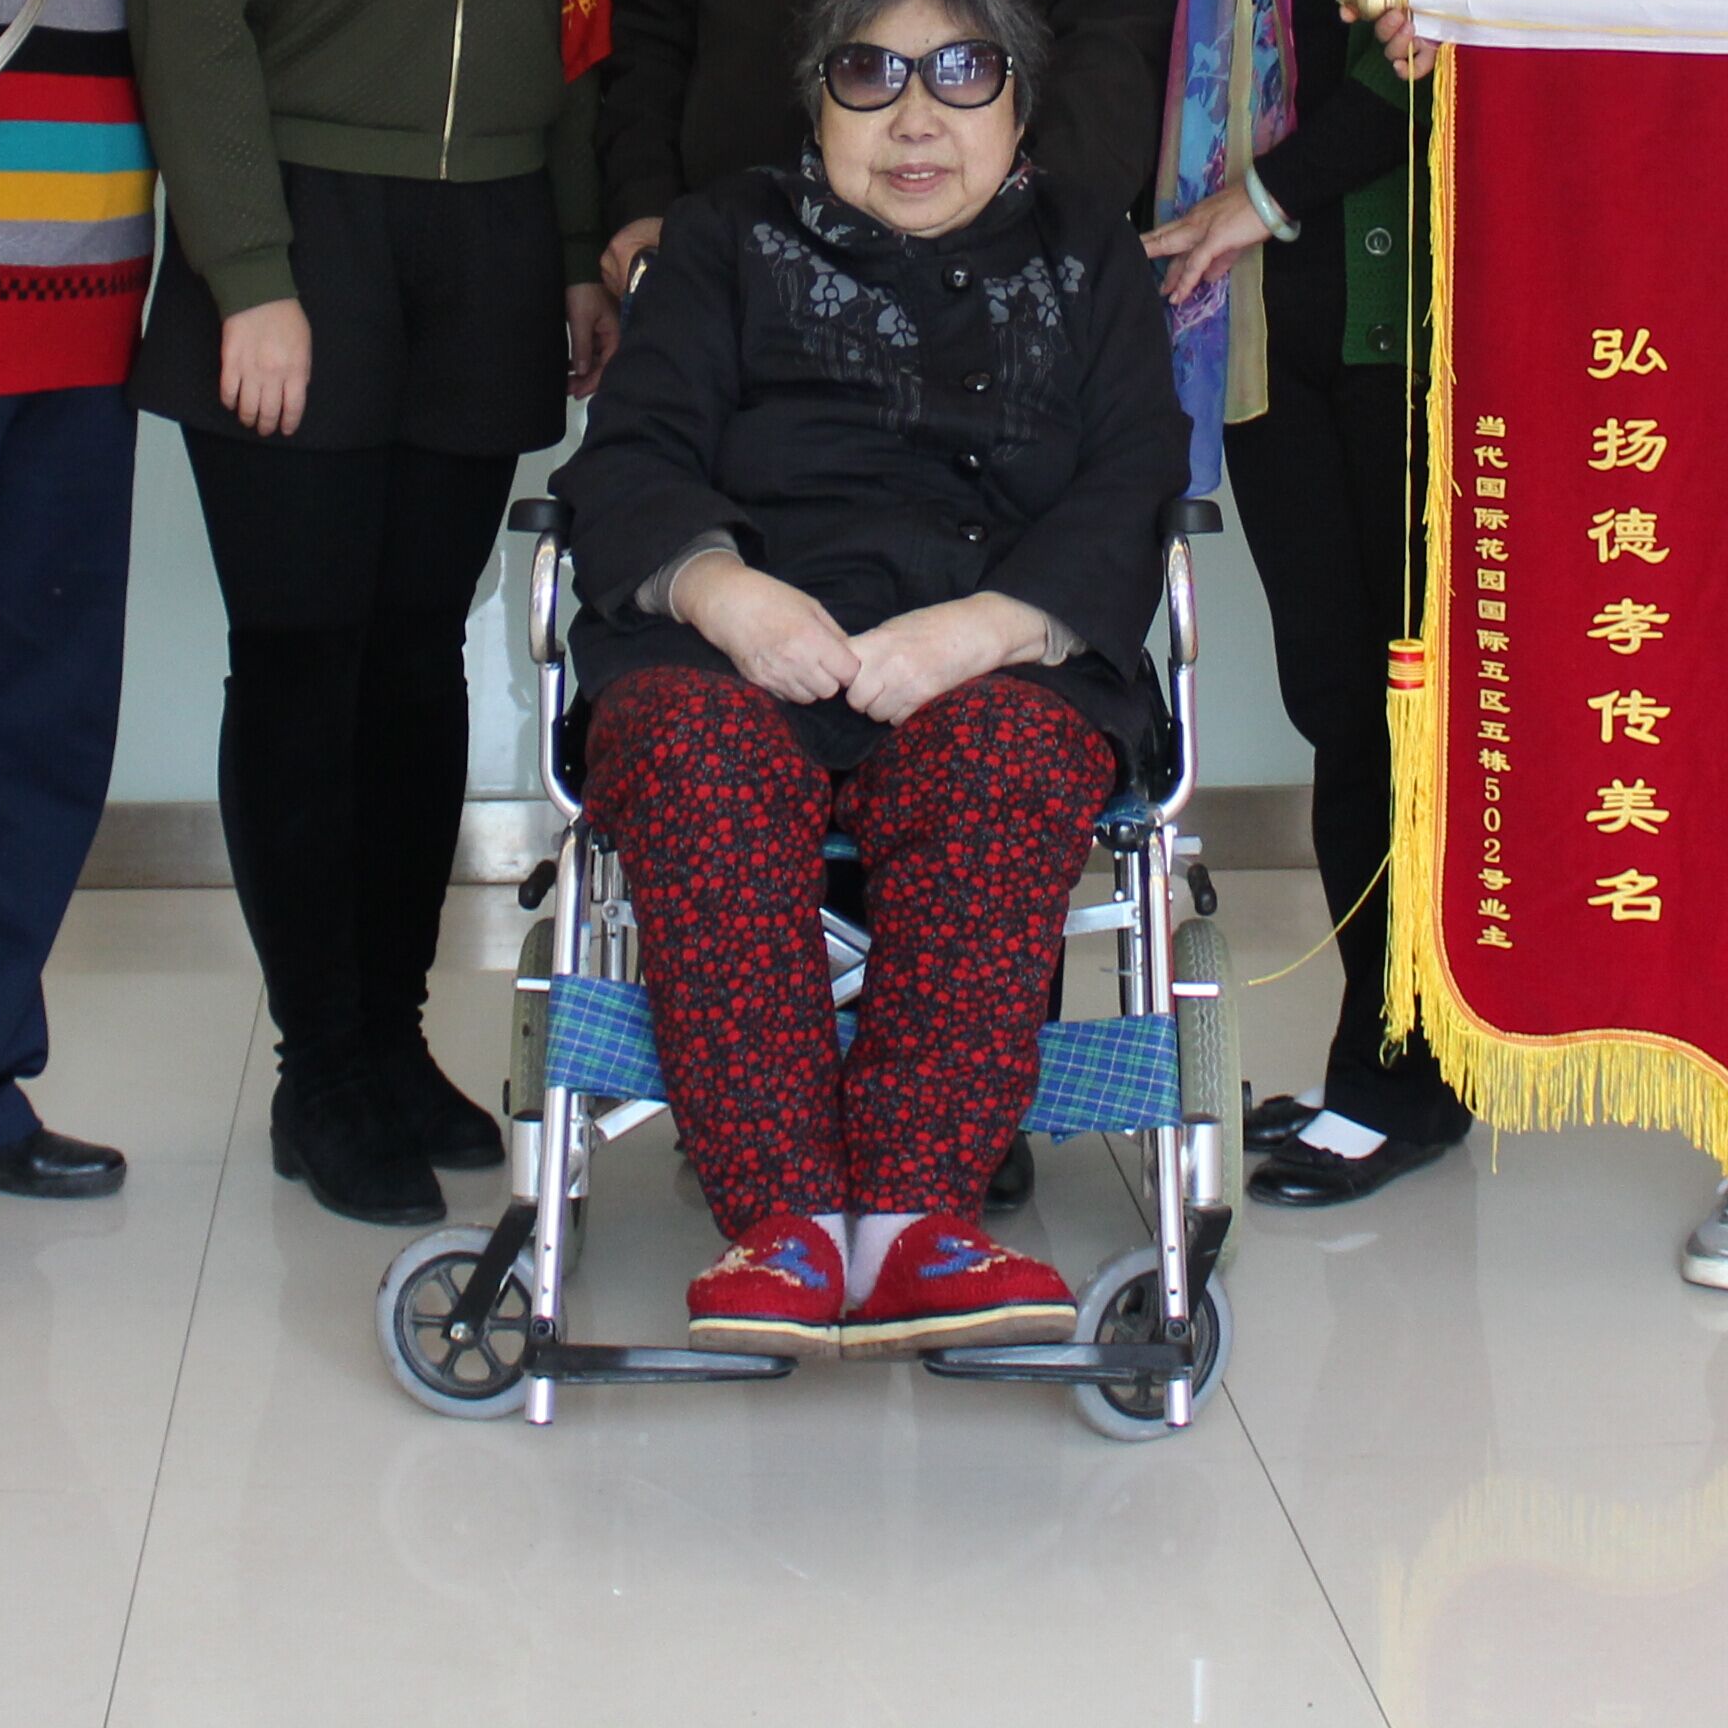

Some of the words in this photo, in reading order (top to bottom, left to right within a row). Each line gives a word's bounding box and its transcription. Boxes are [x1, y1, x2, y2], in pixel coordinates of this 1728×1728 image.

[1474, 414, 1513, 949] 当代国际花园国际五区五栋502号业主
[1586, 327, 1671, 922] 弘扬德孝传美名
